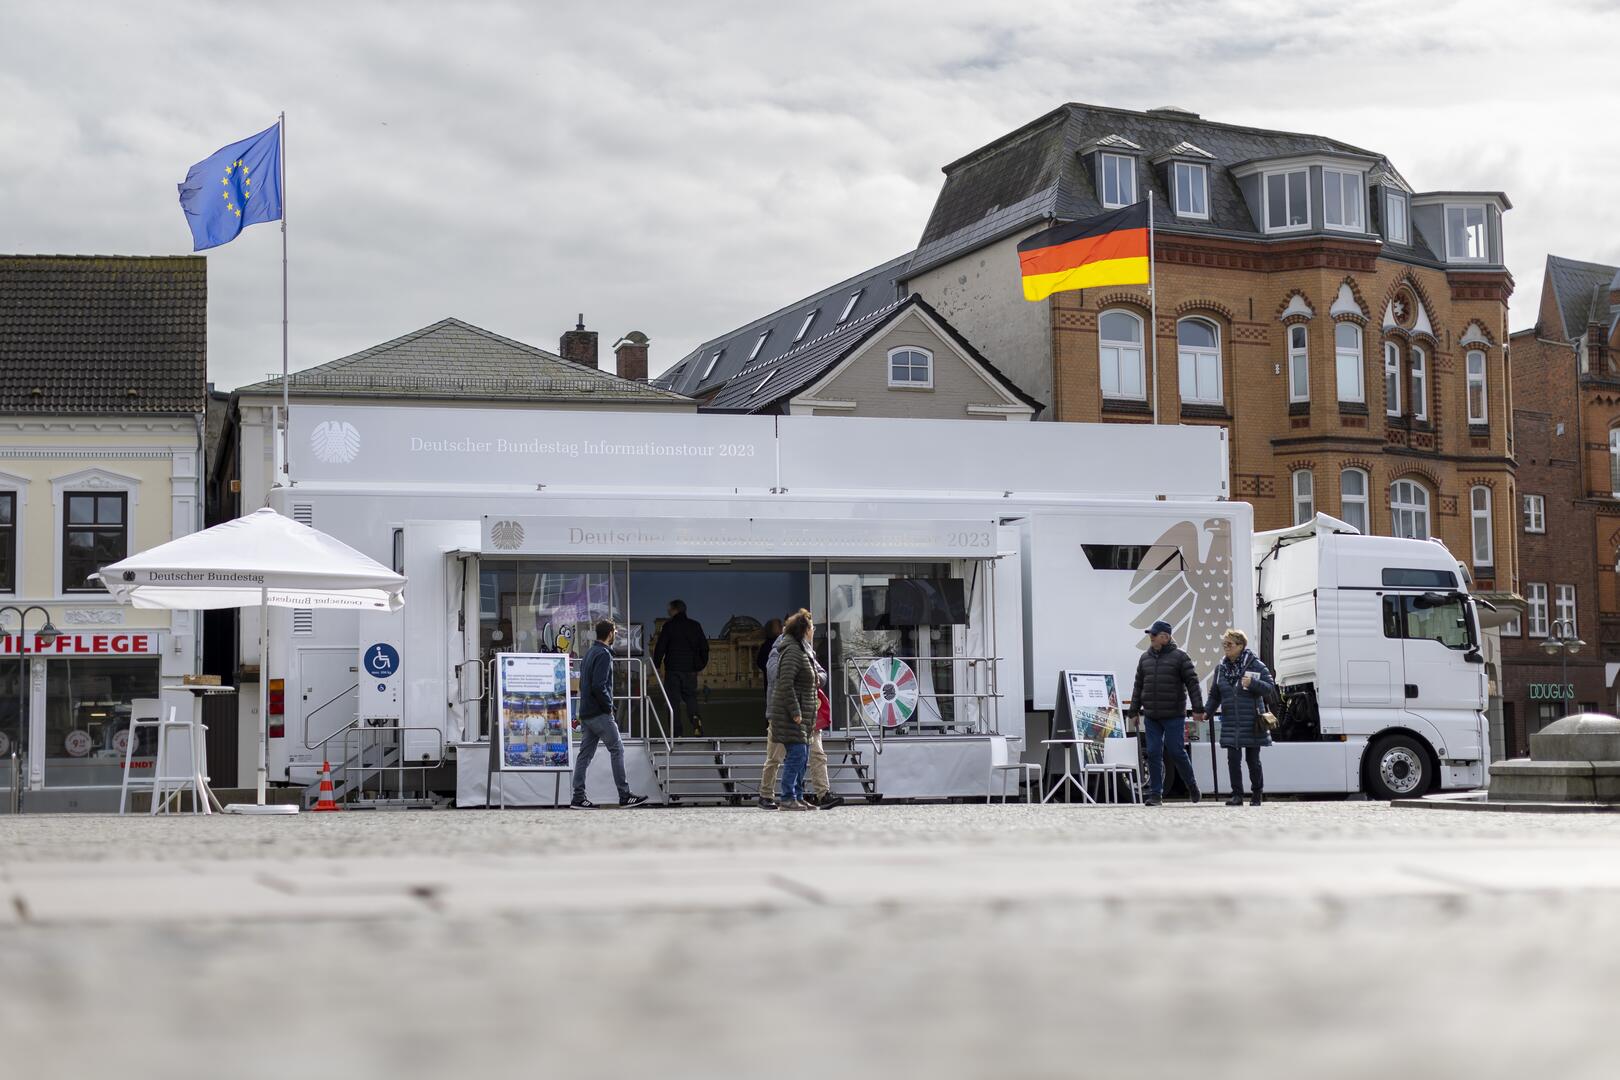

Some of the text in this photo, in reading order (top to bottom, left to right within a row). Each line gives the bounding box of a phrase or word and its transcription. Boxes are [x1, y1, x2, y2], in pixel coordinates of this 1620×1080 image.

[410, 436, 755, 458] Deutscher Bundestag Informationstour 2023
[946, 531, 990, 548] 2023
[149, 571, 265, 584] Deutscher Bundestag
[1529, 683, 1575, 699] DOUGLAS
